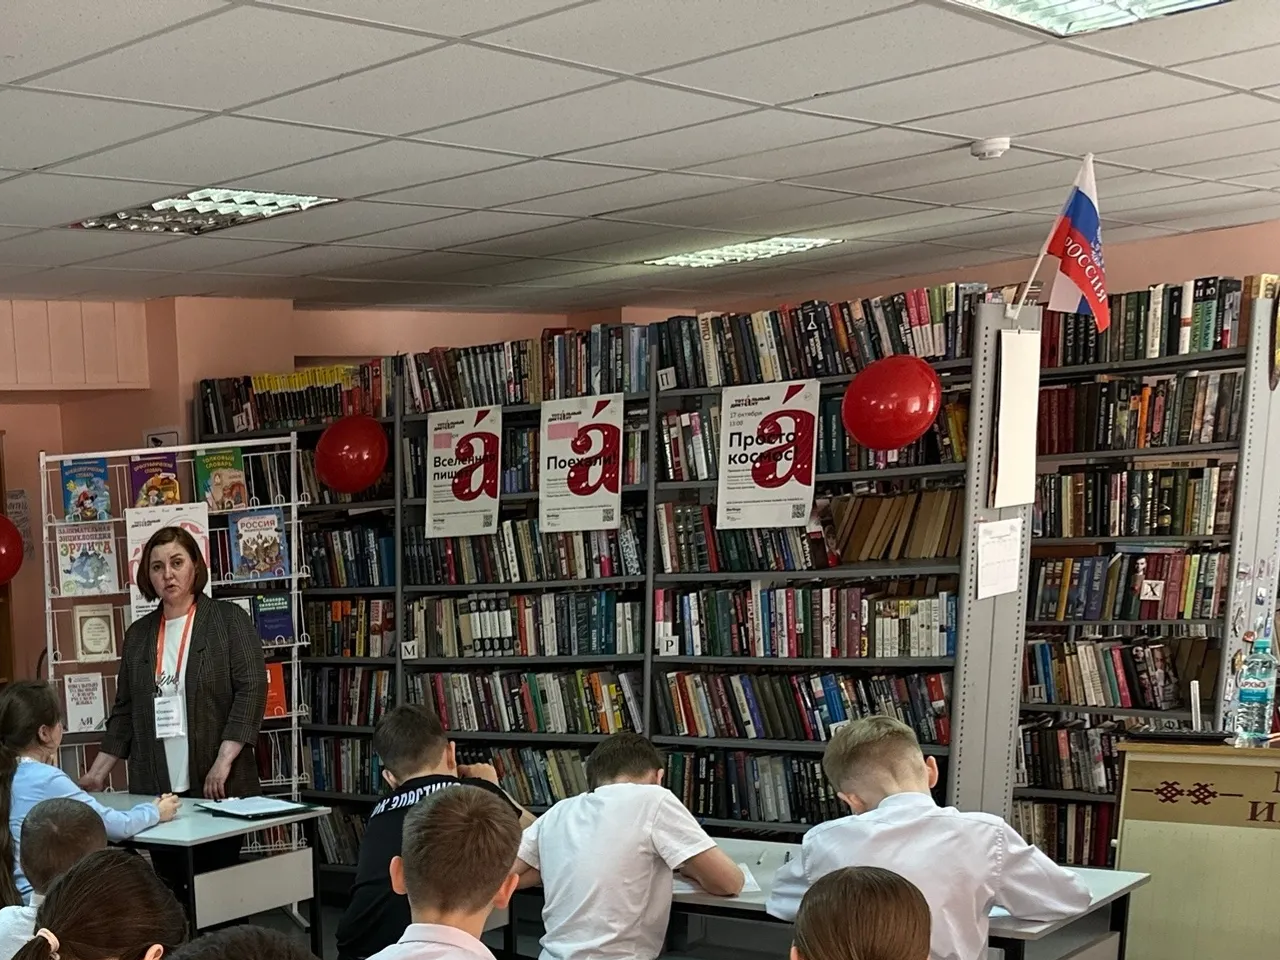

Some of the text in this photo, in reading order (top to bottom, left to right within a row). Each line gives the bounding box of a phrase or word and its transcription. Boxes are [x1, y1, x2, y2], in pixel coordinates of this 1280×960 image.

[729, 431, 796, 451] Просто
[203, 455, 235, 463] ТОЛКОВЫЙ
[206, 461, 233, 469] СЛОВАРЬ
[240, 519, 276, 529] РОССИЯ
[404, 645, 416, 657] М
[1246, 801, 1280, 823] И
